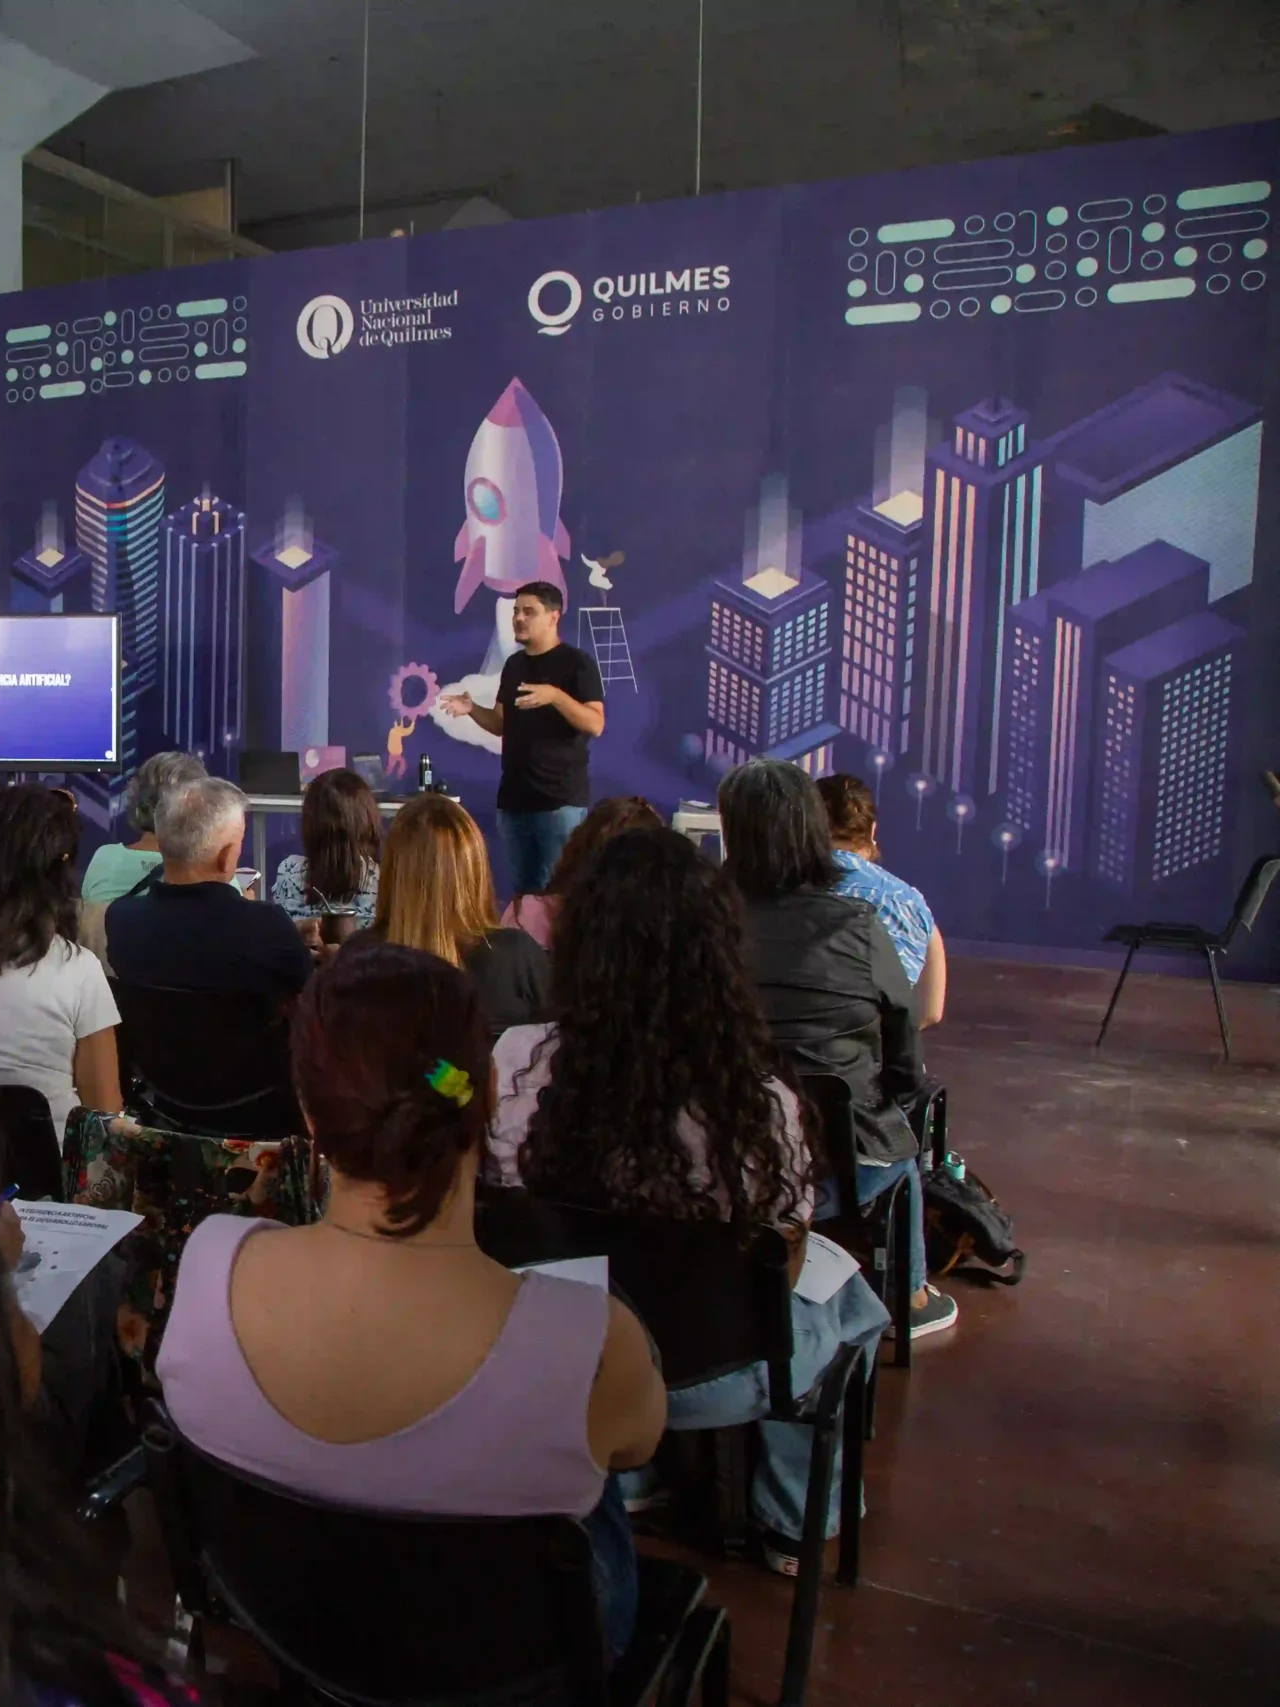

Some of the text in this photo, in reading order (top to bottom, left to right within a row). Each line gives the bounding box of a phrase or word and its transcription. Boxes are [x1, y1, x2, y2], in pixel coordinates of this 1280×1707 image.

[593, 265, 731, 303] QUILMES
[360, 289, 459, 315] Universidad
[592, 297, 730, 322] GOBIERNO
[361, 309, 432, 331] Nacional
[359, 326, 452, 348] de Quilmes
